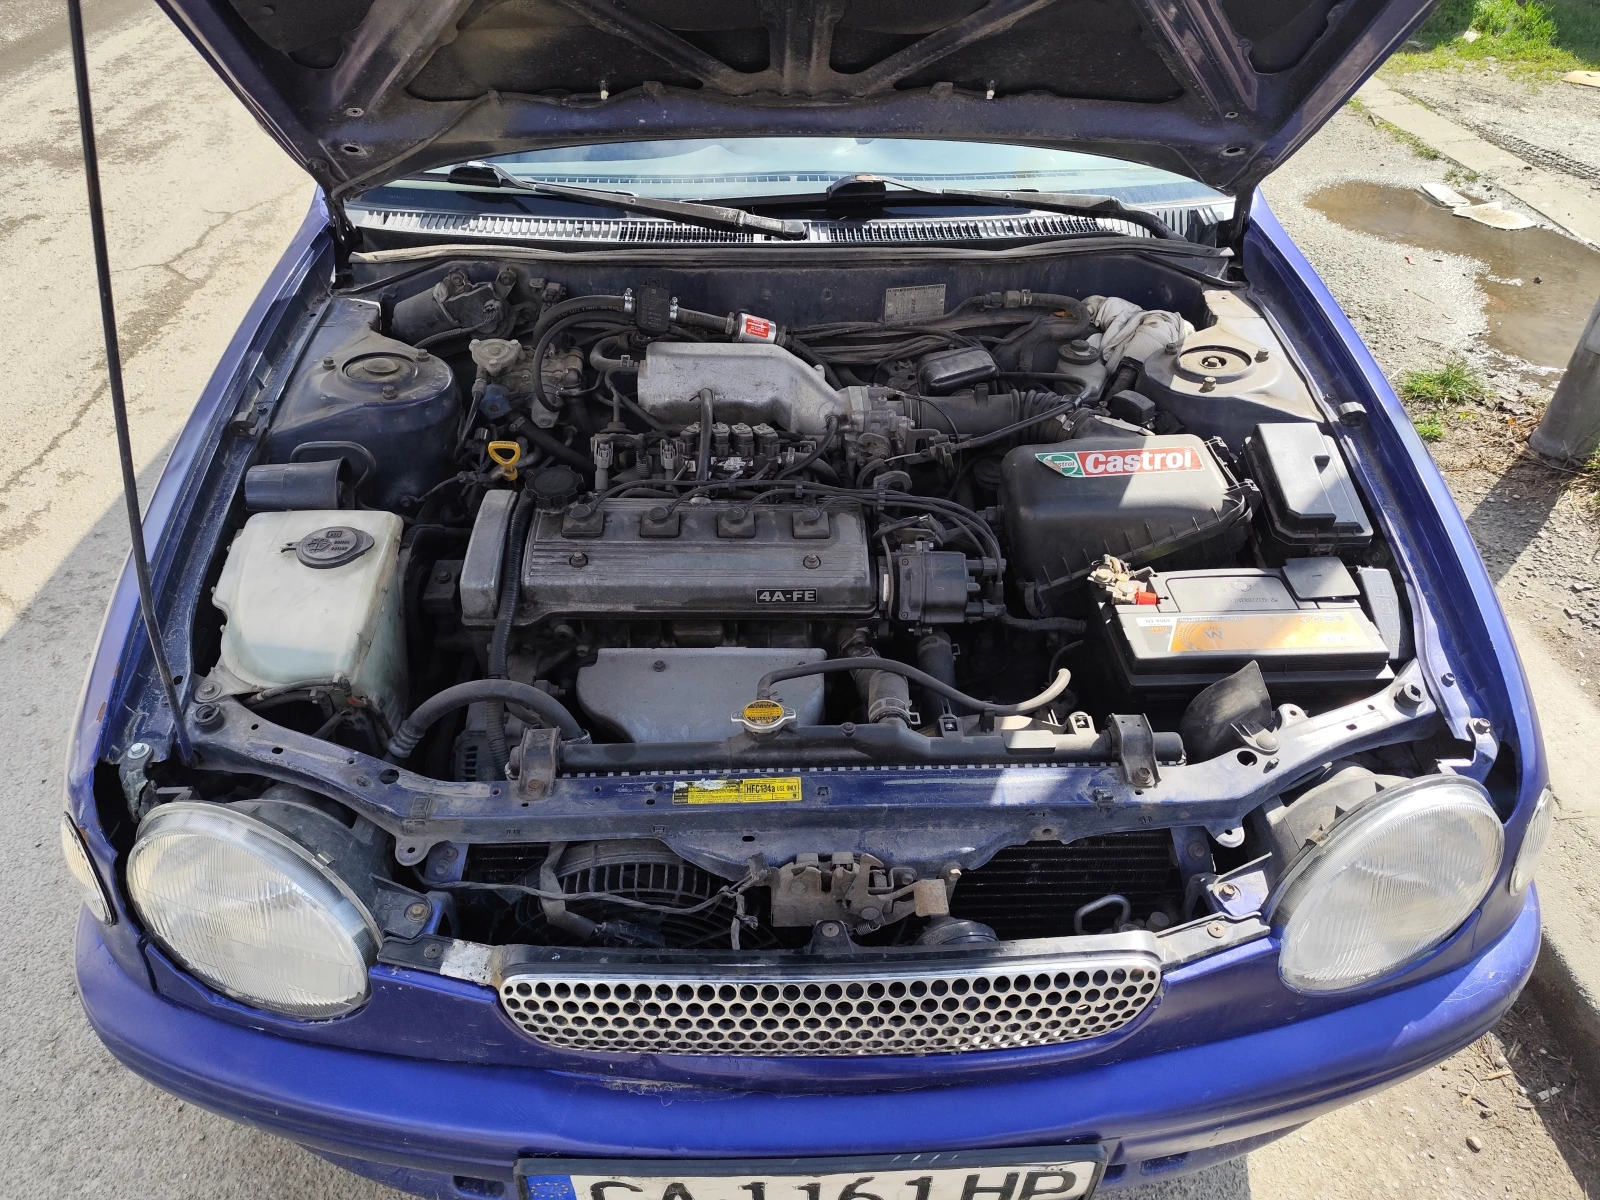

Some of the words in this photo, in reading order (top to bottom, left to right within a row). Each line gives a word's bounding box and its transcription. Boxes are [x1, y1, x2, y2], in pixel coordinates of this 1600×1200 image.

[1085, 450, 1193, 473] Castrol
[759, 591, 815, 602] 4A-FE
[746, 784, 775, 794] HFC134a
[590, 1181, 696, 1200] CA
[738, 1175, 934, 1200] 1161
[961, 1171, 1077, 1200] HP
